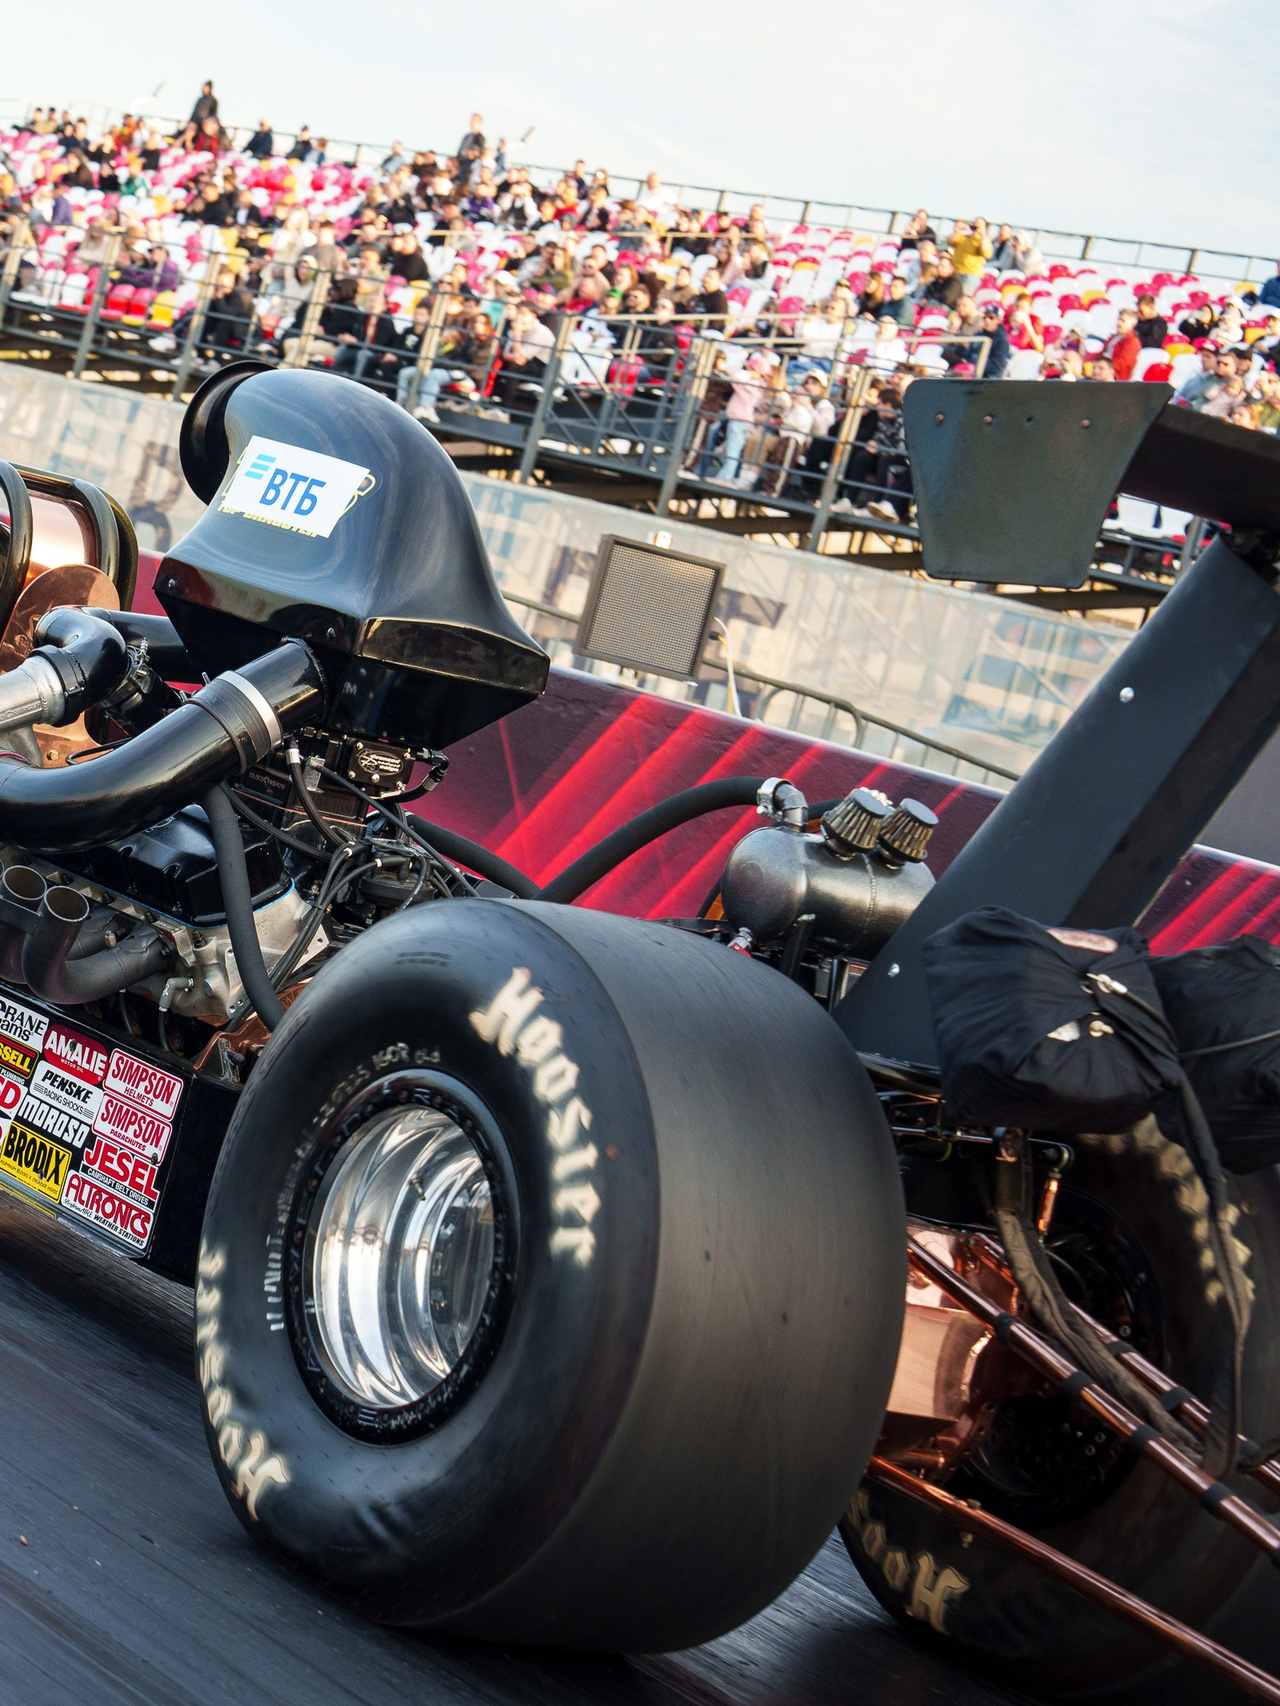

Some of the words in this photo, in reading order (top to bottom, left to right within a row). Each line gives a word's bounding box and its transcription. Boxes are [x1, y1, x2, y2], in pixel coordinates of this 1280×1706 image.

[259, 468, 326, 516] ВТБ
[44, 1030, 108, 1077] AMALIE
[61, 1058, 77, 1069] MOTOR
[41, 1069, 93, 1104] PENSKE
[43, 1087, 62, 1104] RACING
[62, 1098, 84, 1114] SHOCKS
[111, 1056, 176, 1105] SIMPSON
[124, 1086, 154, 1107] HELMETS
[18, 1095, 90, 1148] MOROSO
[101, 1099, 165, 1148] SIMPSON
[110, 1128, 146, 1152] PARACHUTES
[3, 1125, 66, 1186] BRODIX
[85, 1139, 158, 1201] JESEL
[65, 1173, 151, 1239] ALTRONICS
[87, 1168, 114, 1188] CAMSHAFT
[115, 1181, 130, 1196] BELT
[129, 1189, 149, 1205] DRIVES
[94, 1214, 118, 1234] WEATHER
[118, 1229, 144, 1247] STATIONS
